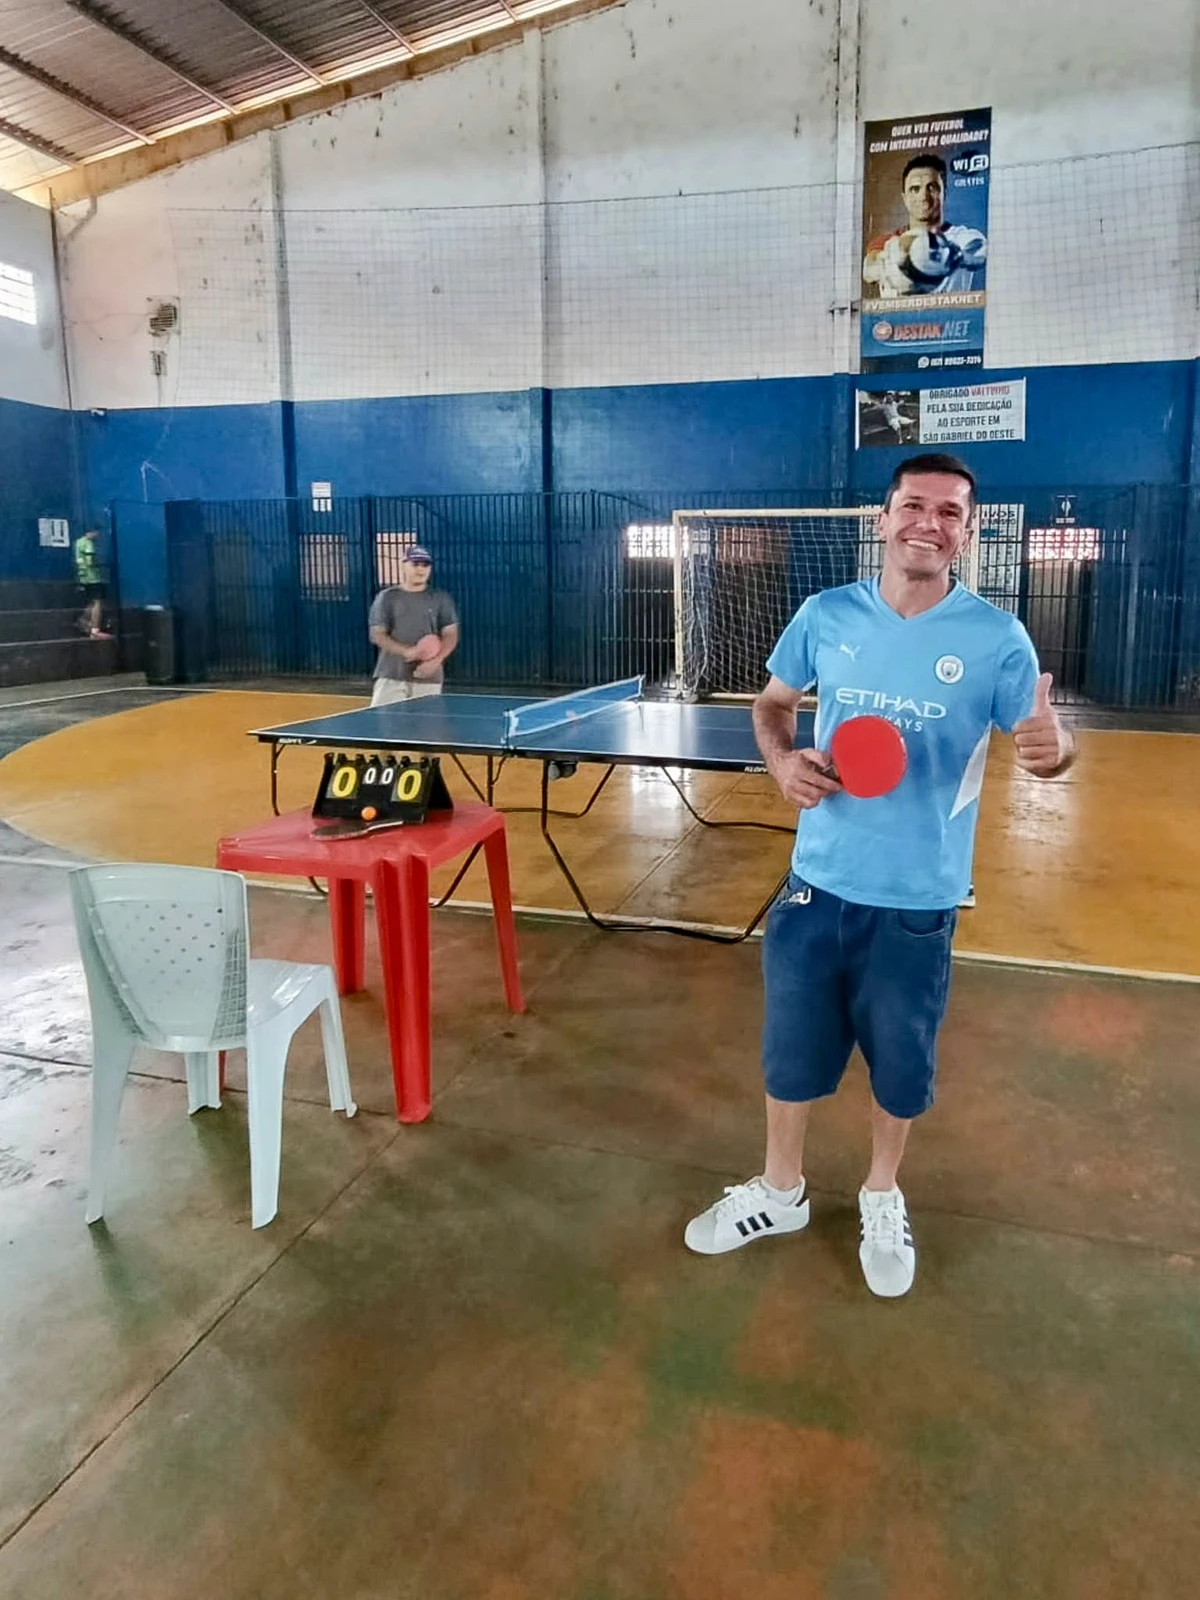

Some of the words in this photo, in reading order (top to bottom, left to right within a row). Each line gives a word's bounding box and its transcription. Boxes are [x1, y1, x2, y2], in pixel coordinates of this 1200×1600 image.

[891, 125, 912, 137] QUER
[914, 122, 930, 134] VER
[930, 119, 964, 132] FUTEBOL
[869, 142, 888, 153] COM
[889, 137, 928, 151] INTERNET
[928, 136, 939, 147] DE
[940, 129, 989, 145] QUALIDADE?
[929, 388, 970, 400] OBRIGADO
[926, 403, 947, 414] PELA
[948, 402, 965, 413] SUA
[966, 398, 1013, 412] DEDICAÇÃO
[937, 417, 948, 428] AO
[950, 415, 987, 427] ESPORTE
[988, 415, 1000, 426] EM
[923, 431, 939, 443] SÃO
[940, 431, 973, 442] GABRIEL
[976, 430, 988, 440] DO
[989, 428, 1015, 439] OESTE
[835, 687, 947, 719] ETIHAD
[332, 766, 358, 798] 0
[397, 769, 422, 801] 0
